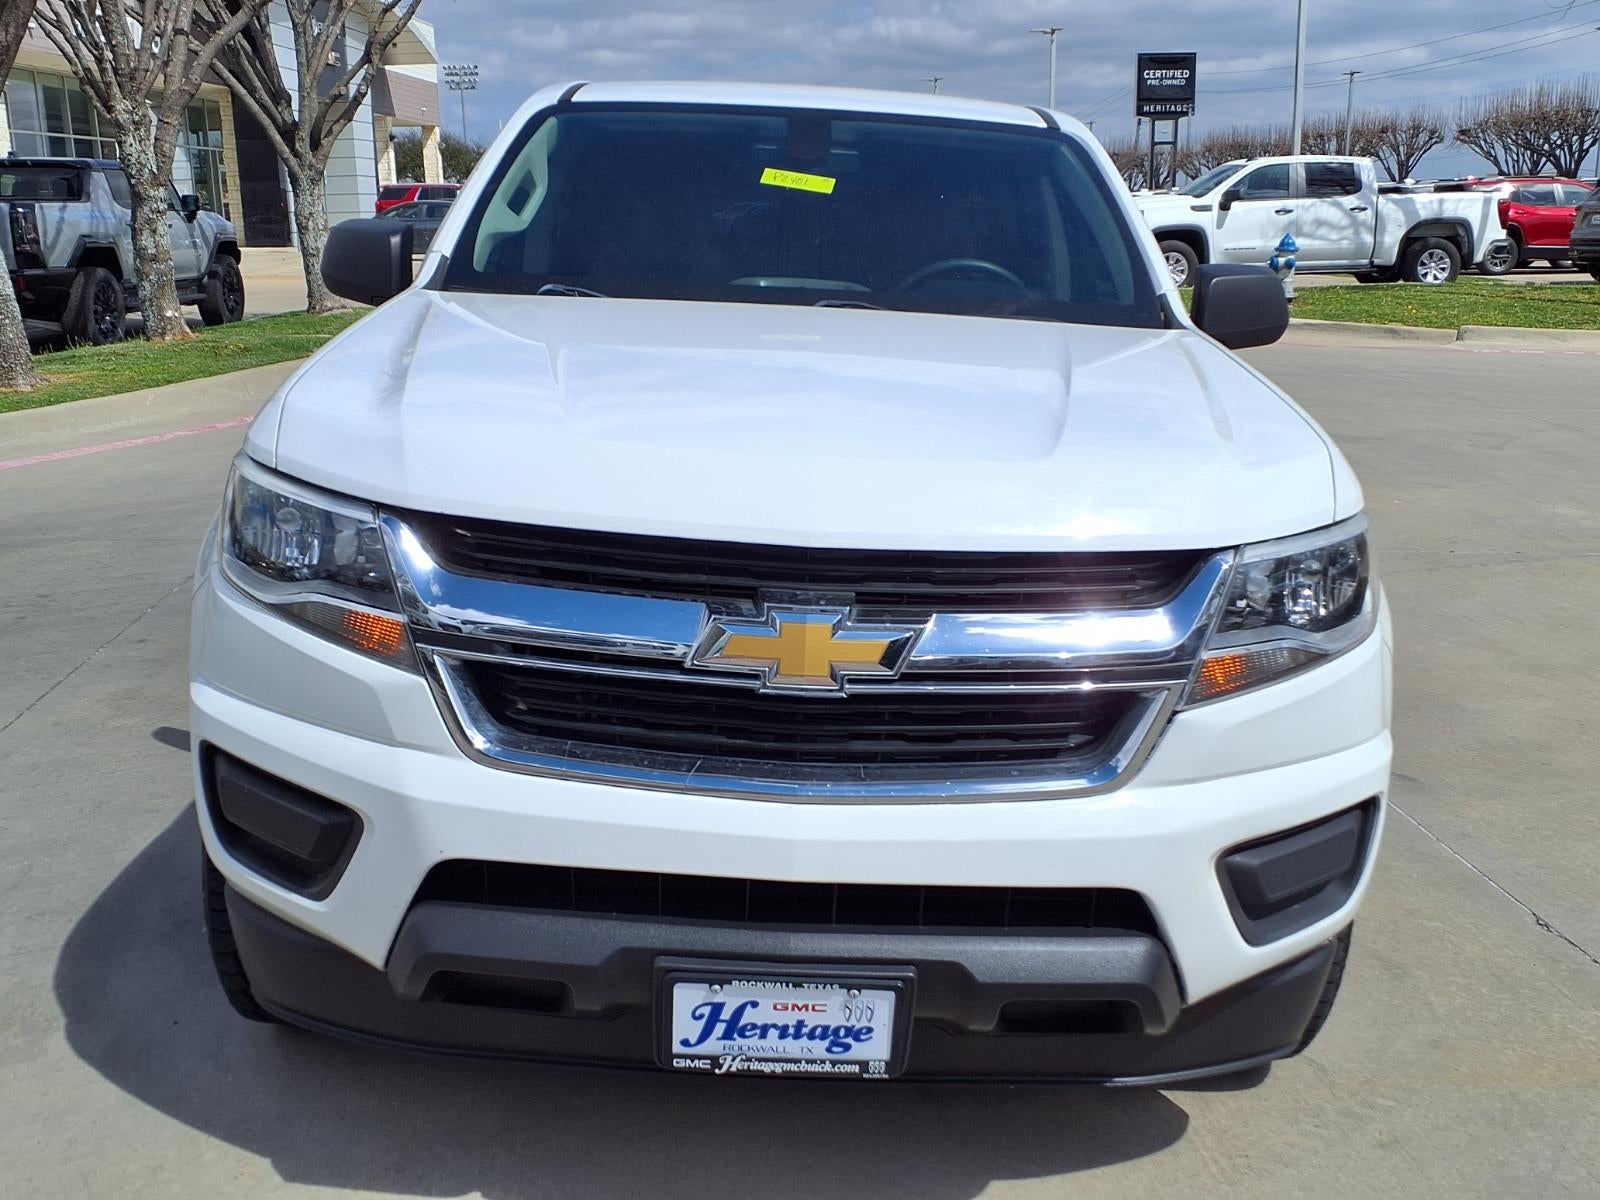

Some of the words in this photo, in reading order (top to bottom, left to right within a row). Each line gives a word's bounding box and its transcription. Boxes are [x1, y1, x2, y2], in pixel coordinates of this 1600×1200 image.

[1143, 69, 1190, 78] CERTIFIED
[1143, 104, 1188, 112] HERITAGE
[802, 983, 840, 992] TEXAS
[772, 1002, 828, 1013] GMC
[679, 1000, 875, 1055] Heritage
[799, 1046, 815, 1055] TX
[672, 1058, 712, 1069] GMC
[714, 1054, 860, 1075] Heritagegmcbuick.com
